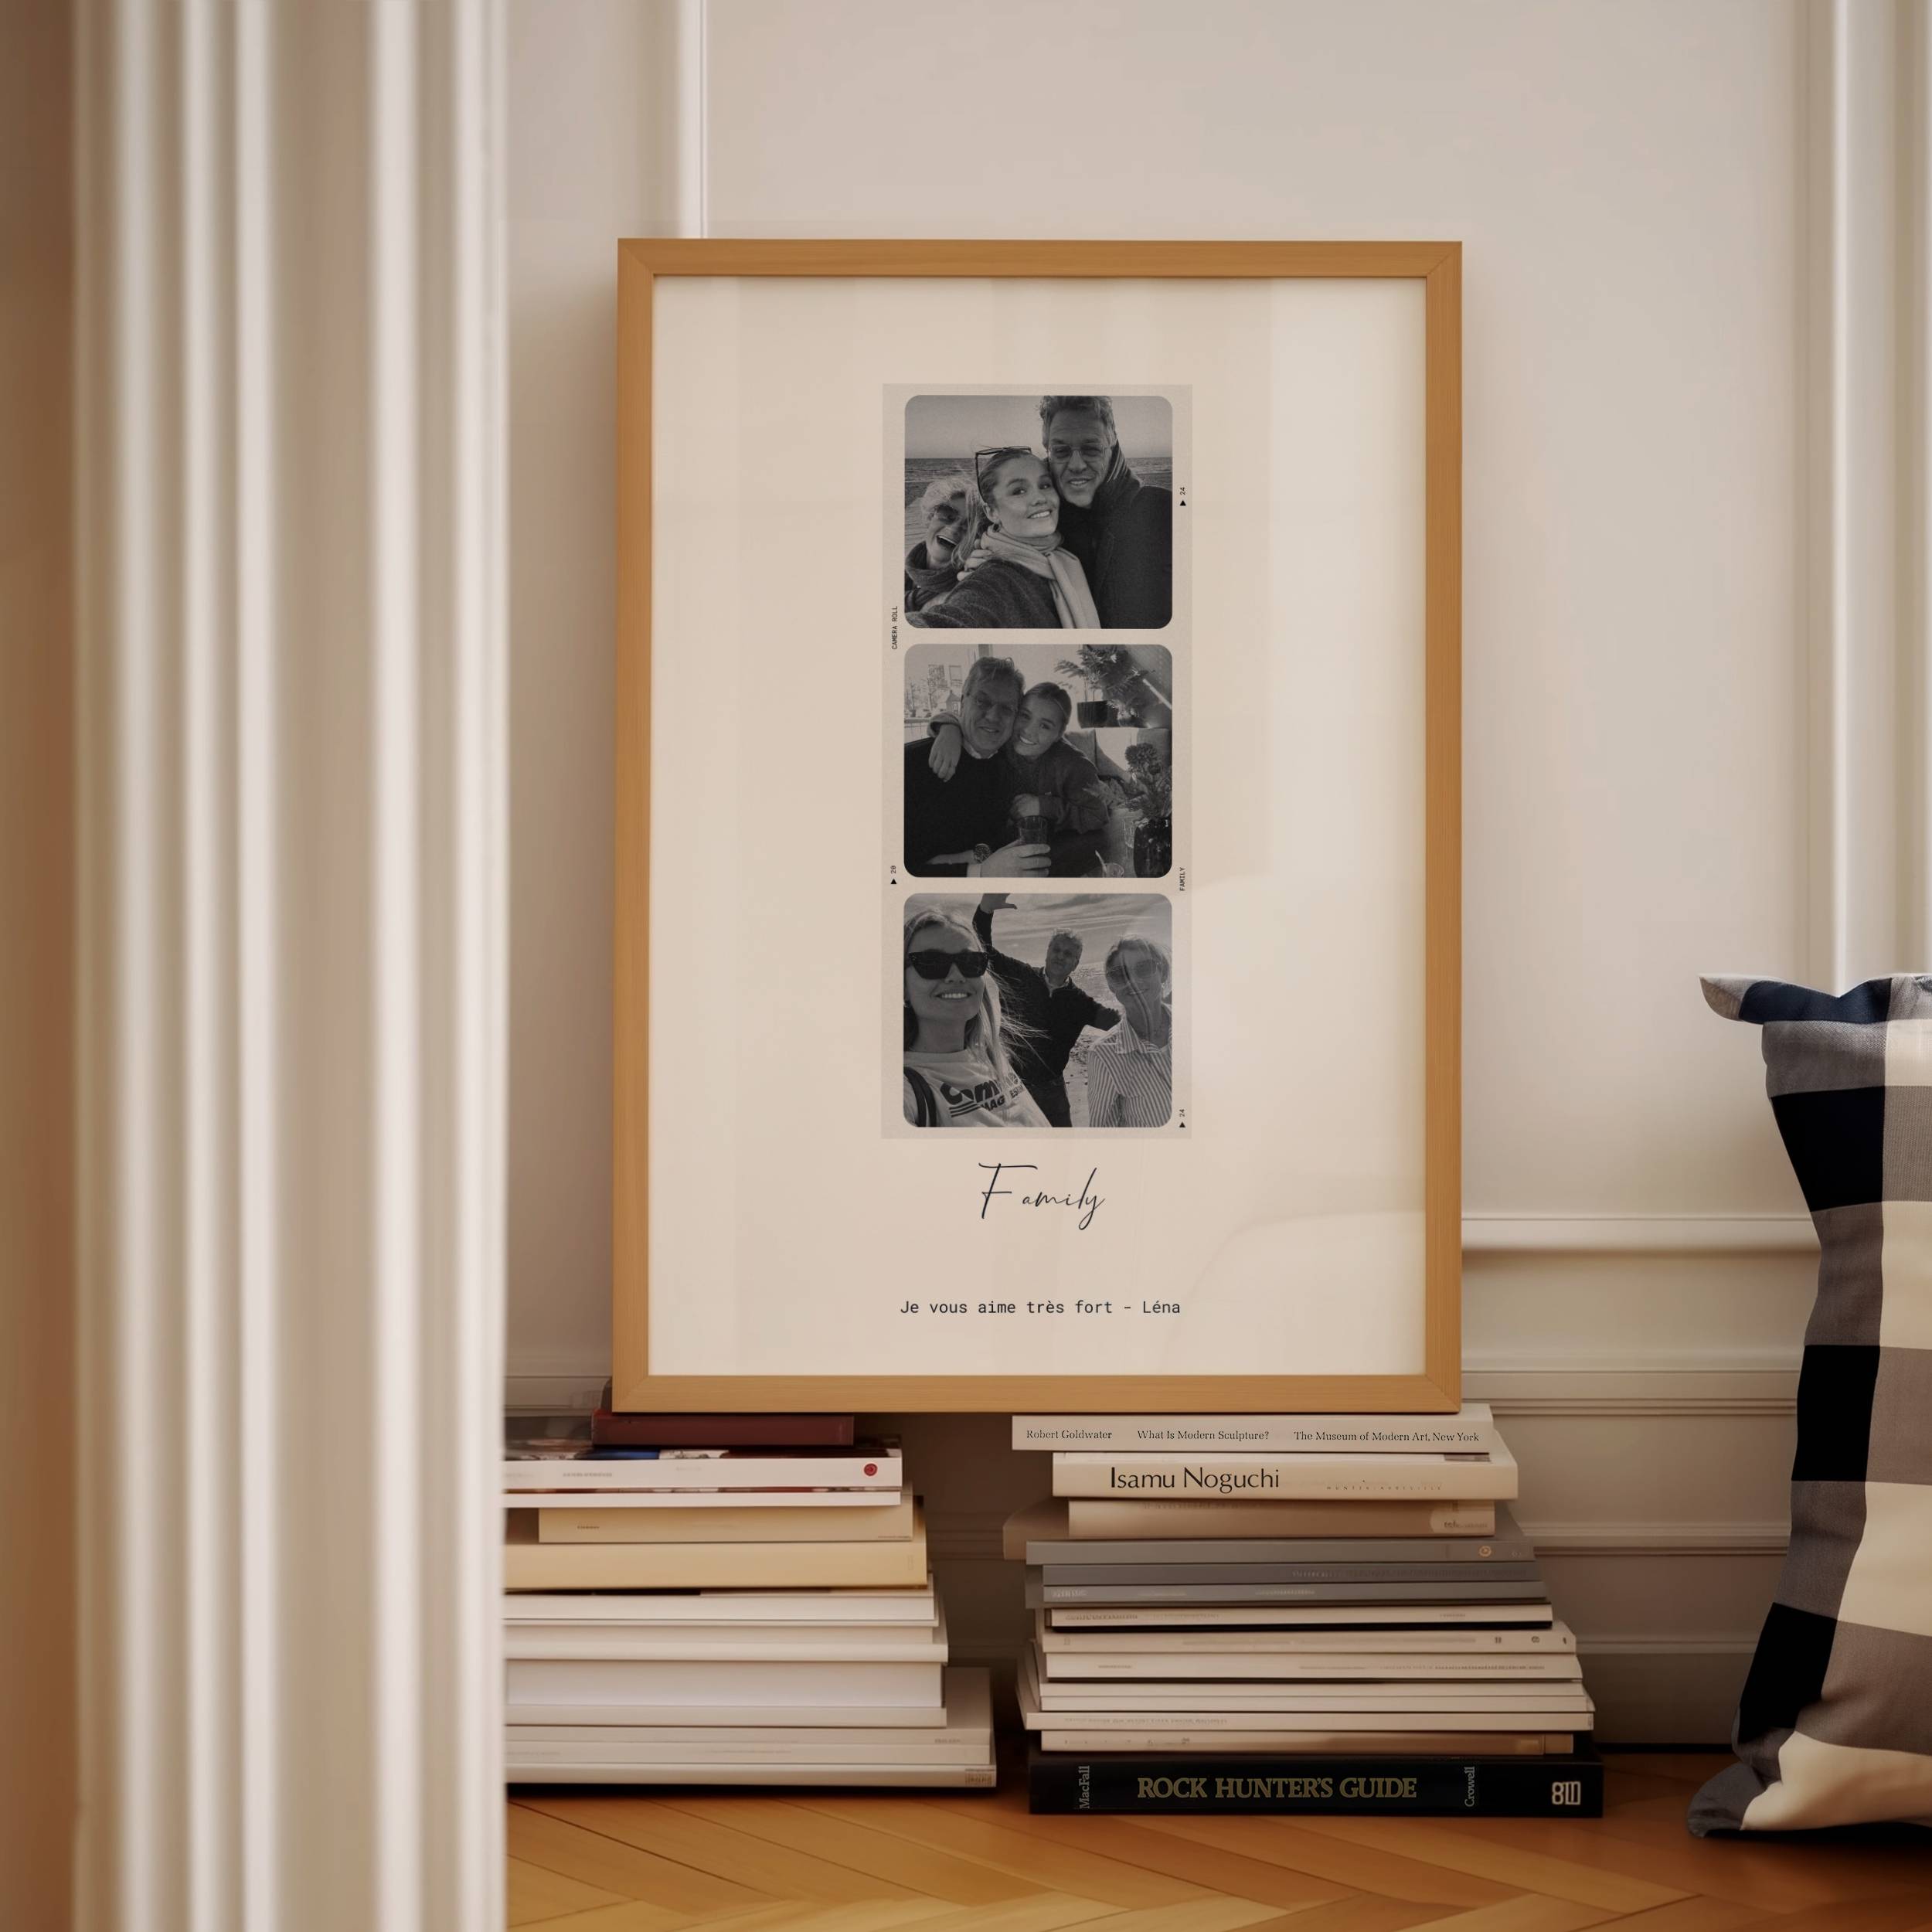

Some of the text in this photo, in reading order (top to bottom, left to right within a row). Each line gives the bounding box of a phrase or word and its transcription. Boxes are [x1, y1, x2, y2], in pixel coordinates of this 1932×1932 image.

[1179, 487, 1185, 495] 24
[978, 1162, 1105, 1231] Family
[900, 1300, 919, 1314] Je
[930, 1303, 968, 1314] vous
[978, 1300, 1016, 1314] aime
[1026, 1300, 1065, 1314] très
[1075, 1299, 1113, 1314] fort
[1143, 1300, 1181, 1314] Léna
[1026, 1428, 1113, 1440] Robert Goldwater
[1137, 1430, 1270, 1442] What Is Modern Sculpture?
[1294, 1430, 1480, 1442] The Museum of Modern Art, New York
[1111, 1466, 1279, 1494] Isamu Noguchi
[1079, 1765, 1090, 1809] MacFall
[1138, 1777, 1417, 1799] ROCK HUNTER'S GUIDE
[1464, 1766, 1475, 1807] Crowell
